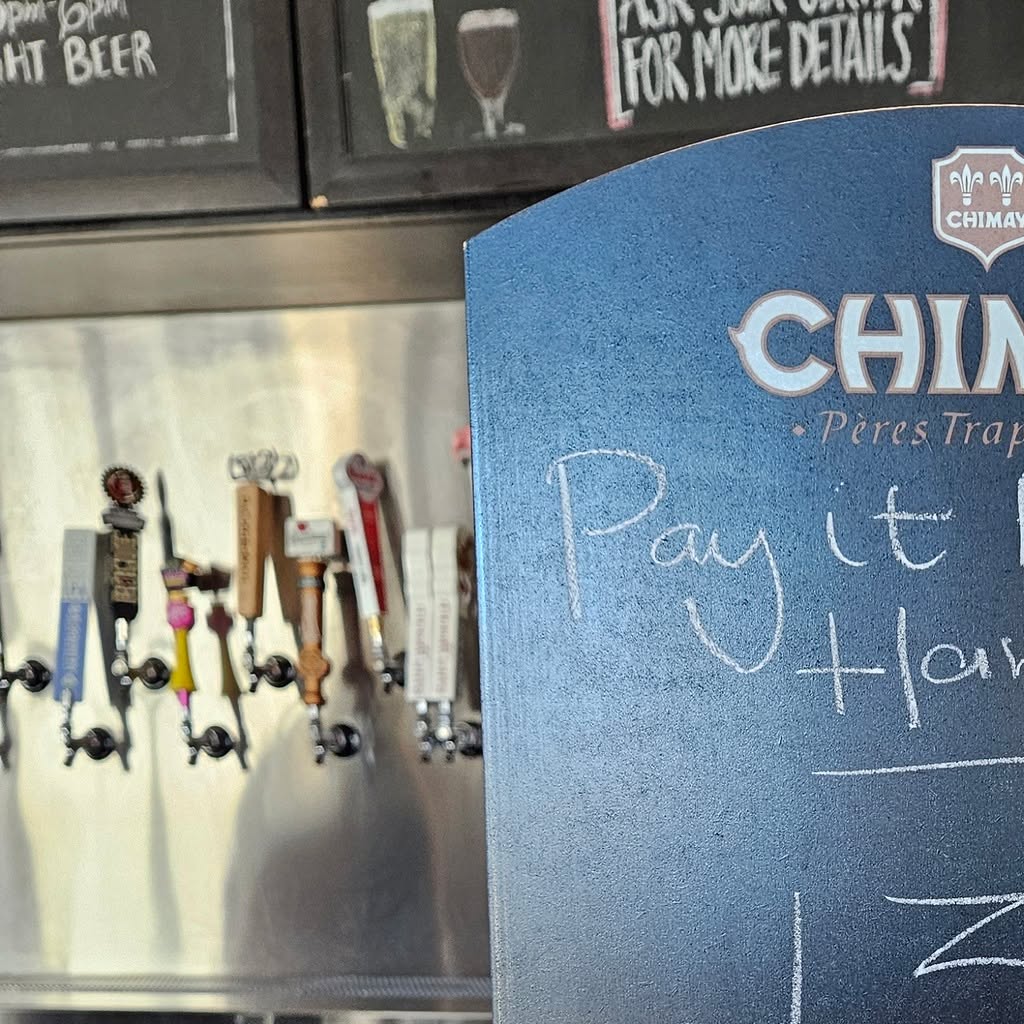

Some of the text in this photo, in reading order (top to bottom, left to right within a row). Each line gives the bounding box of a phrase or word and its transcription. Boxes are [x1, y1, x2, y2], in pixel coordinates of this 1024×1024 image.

[63, 30, 157, 86] BEER
[620, 11, 914, 107] FOR MORE DETAILS
[818, 410, 930, 445] Pères
[546, 449, 785, 674] Pay
[826, 483, 954, 569] it
